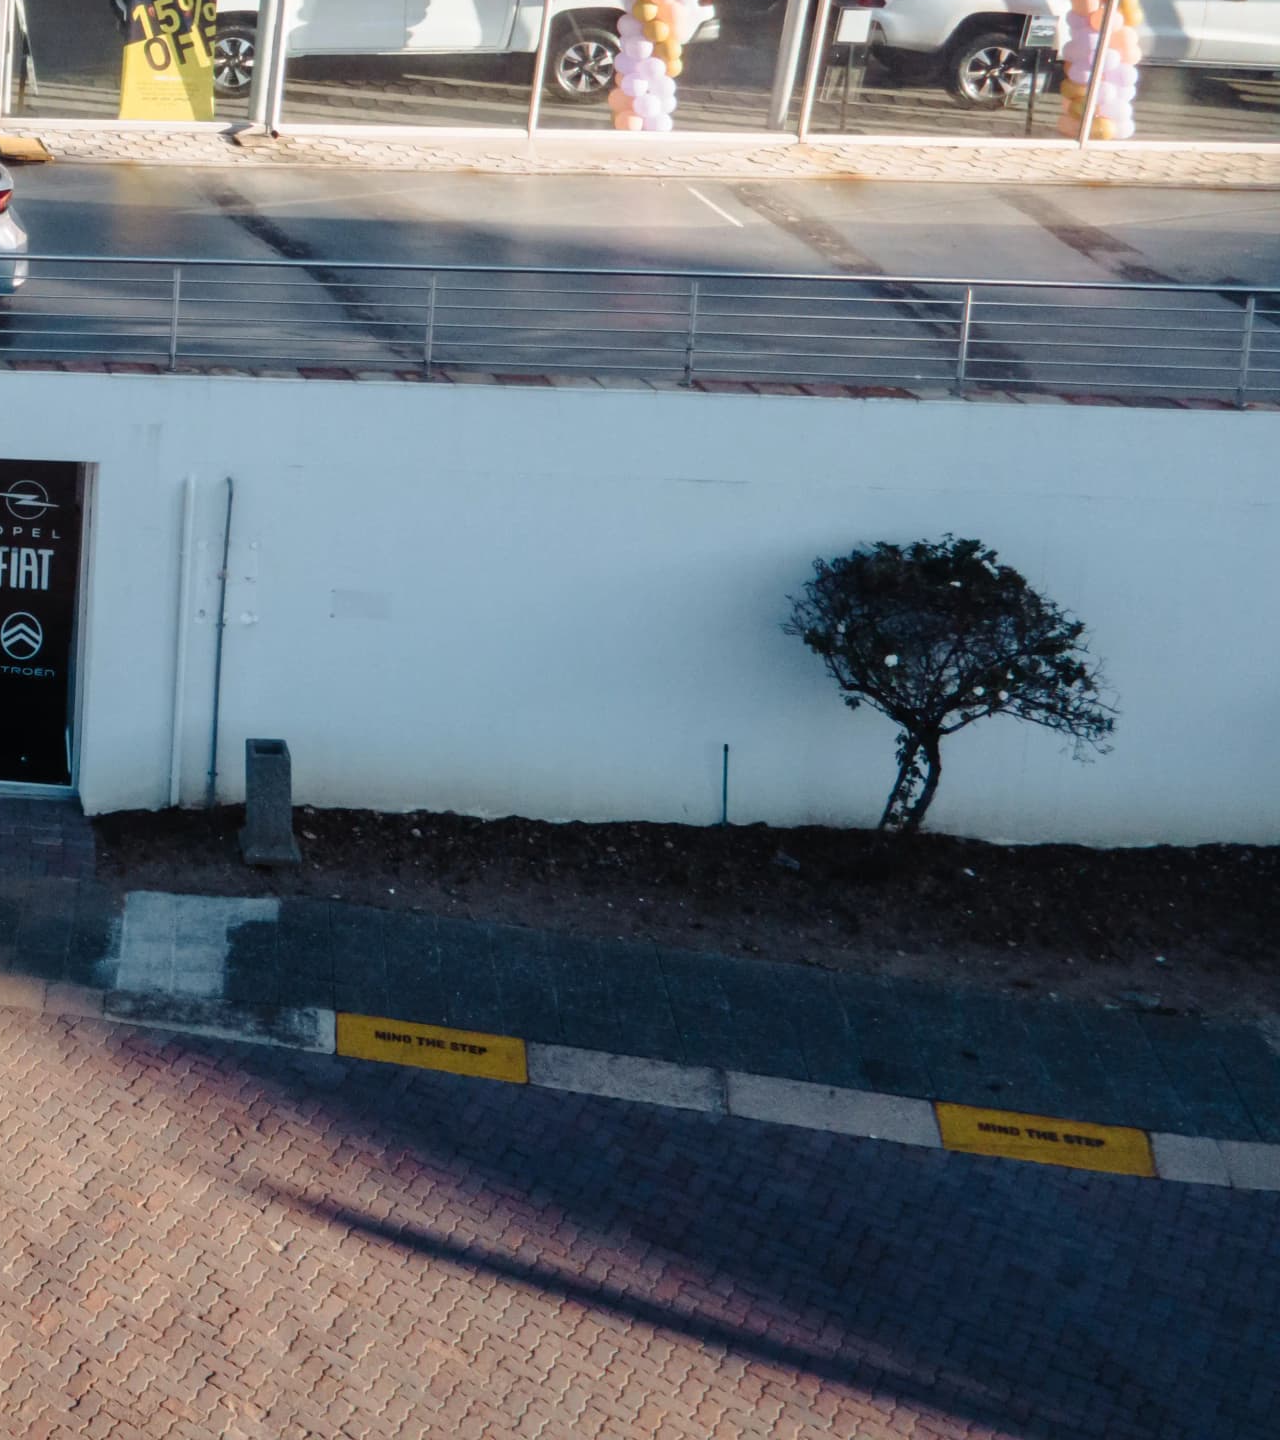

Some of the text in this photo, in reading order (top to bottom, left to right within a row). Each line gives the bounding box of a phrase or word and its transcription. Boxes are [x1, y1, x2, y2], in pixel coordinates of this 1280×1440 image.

[374, 1030, 488, 1056] MIND THE STEP
[978, 1122, 1105, 1148] MIND THE STEP
